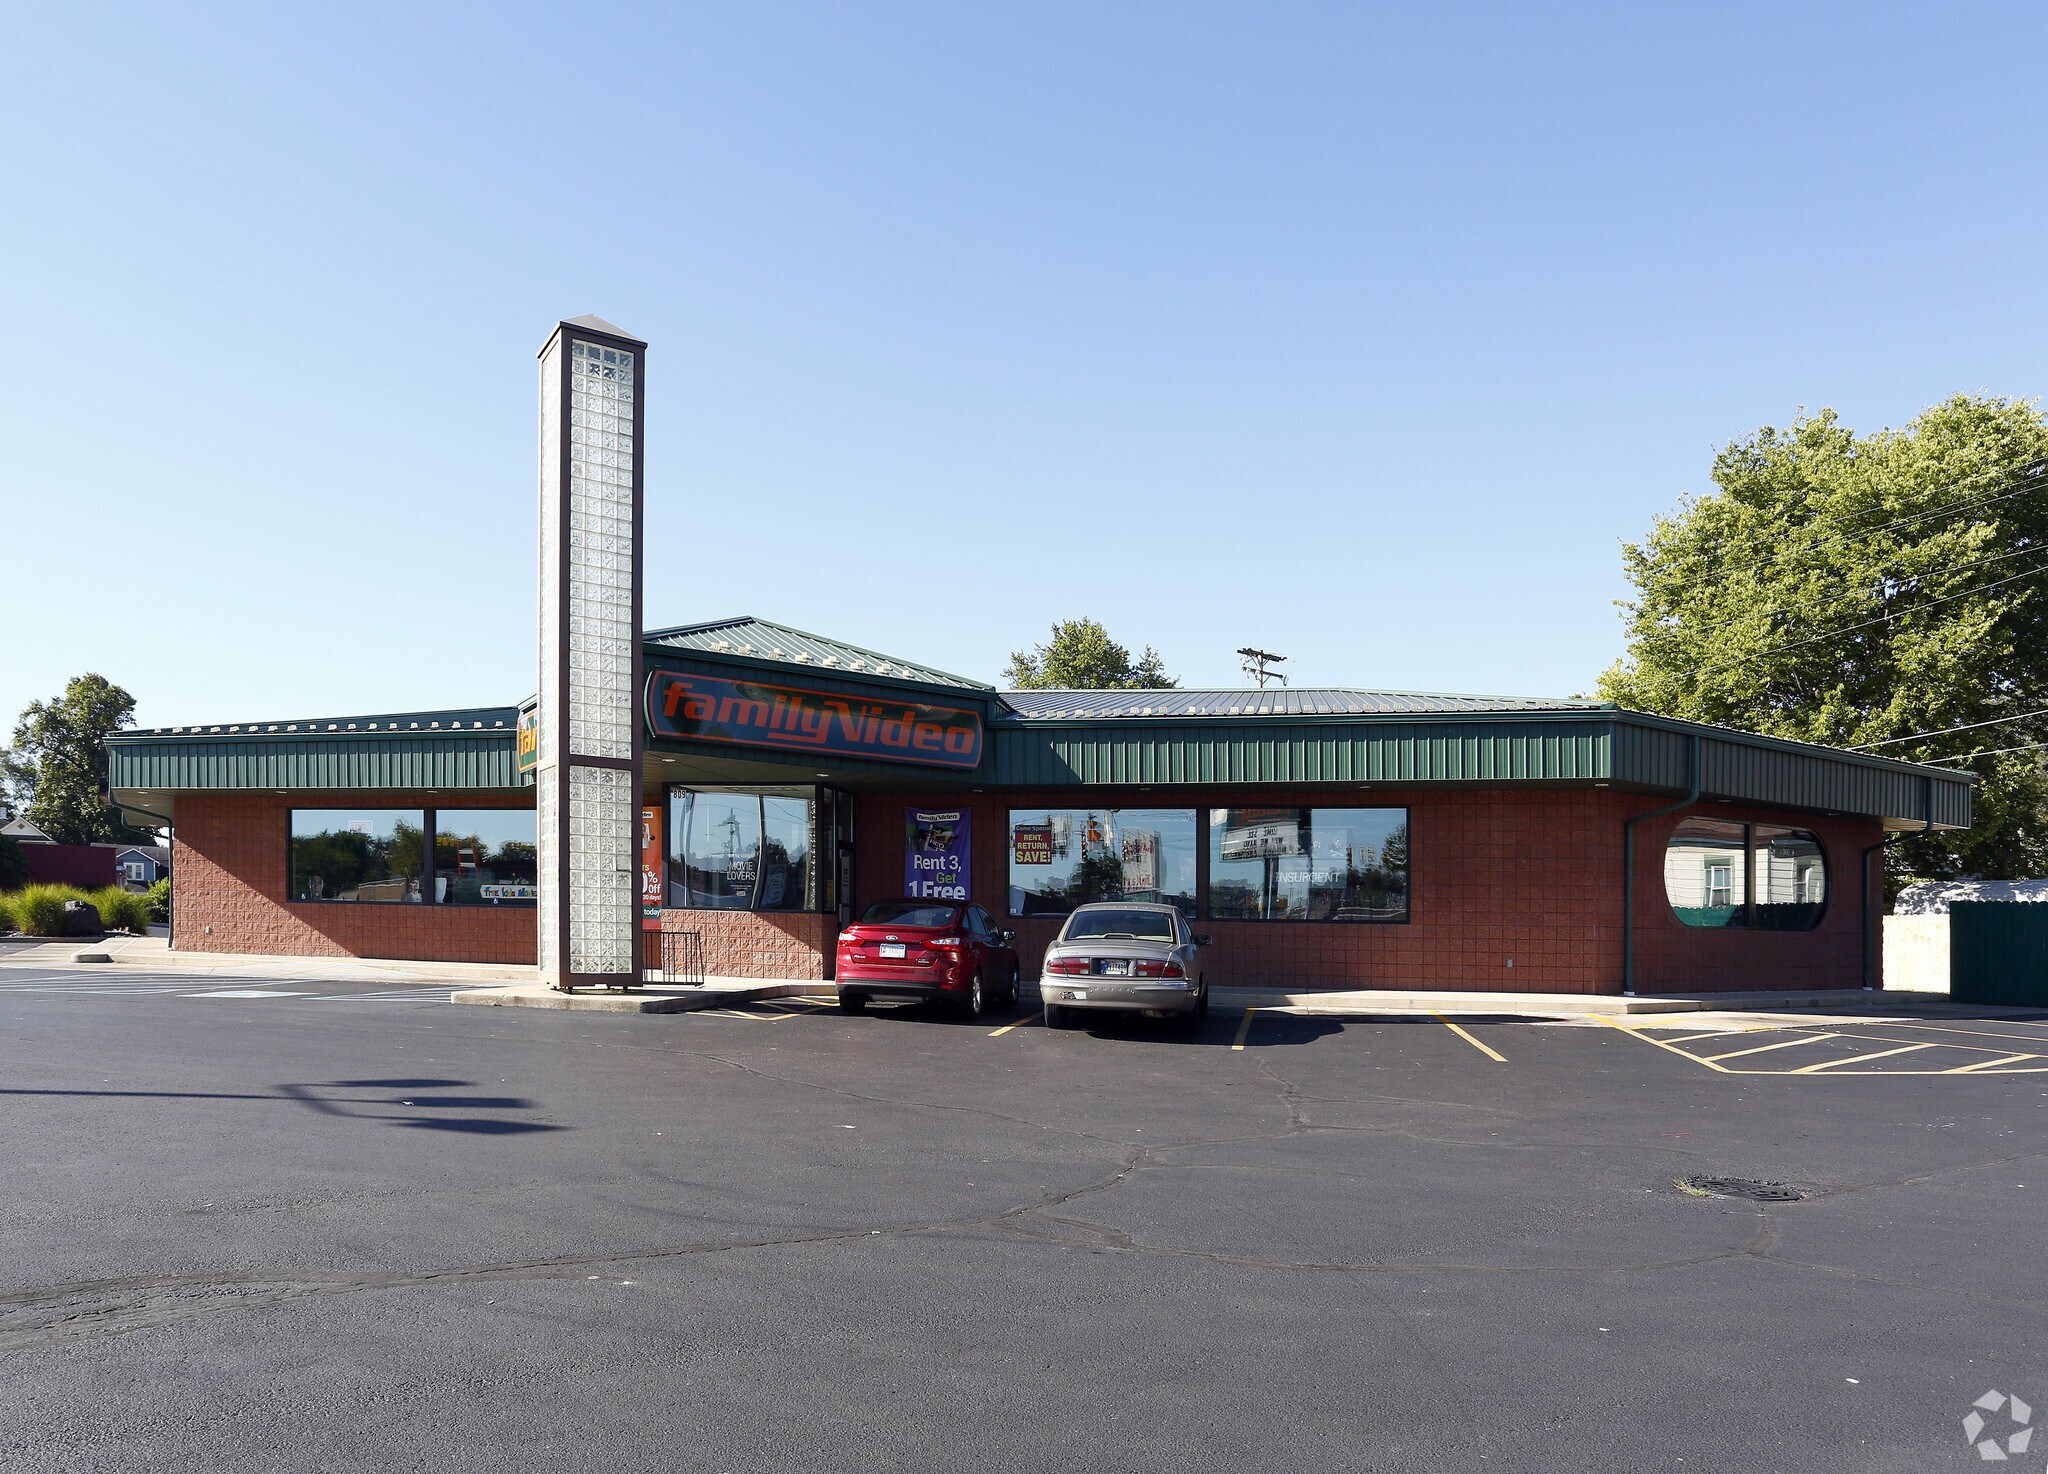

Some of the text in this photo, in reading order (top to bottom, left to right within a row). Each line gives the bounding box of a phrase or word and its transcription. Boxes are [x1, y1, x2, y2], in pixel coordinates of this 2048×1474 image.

[673, 789, 687, 799] 809
[1017, 842, 1050, 850] RETURN,
[1016, 850, 1051, 863] SAVE!
[728, 861, 753, 871] MOVIE
[913, 854, 962, 872] Rent 3,
[726, 871, 756, 881] LOVERS
[936, 872, 956, 884] Get
